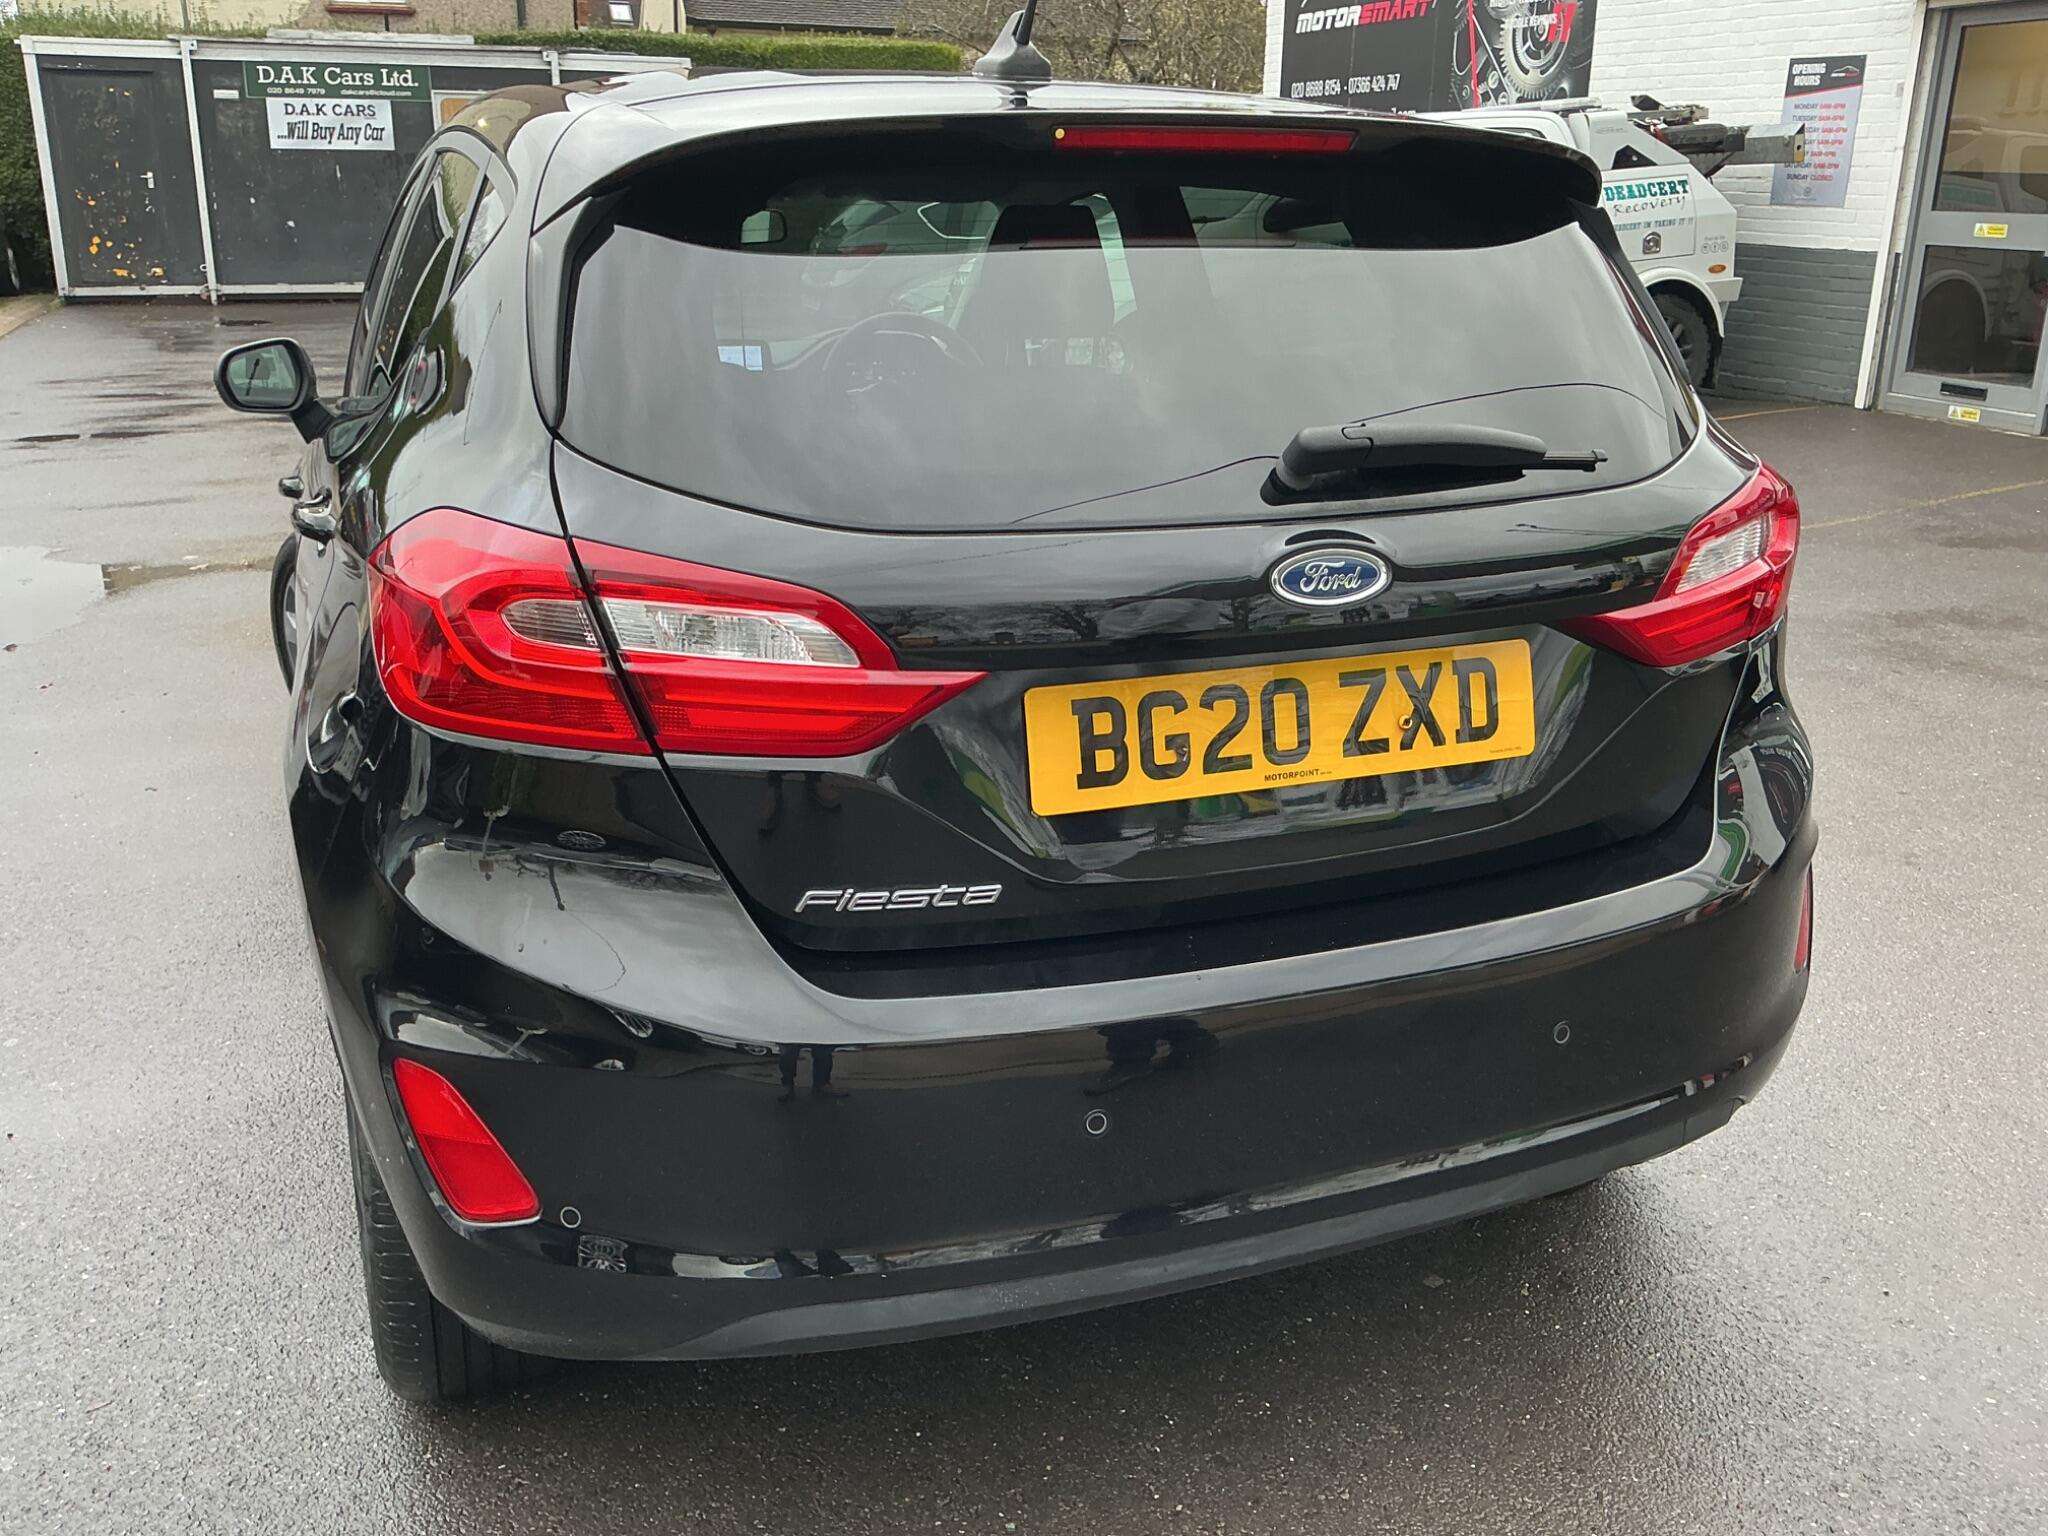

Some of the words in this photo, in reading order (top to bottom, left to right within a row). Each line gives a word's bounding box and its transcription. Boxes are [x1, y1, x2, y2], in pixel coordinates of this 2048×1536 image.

[1296, 0, 1429, 34] MOTORSMART
[256, 65, 318, 85] D.A.K
[324, 67, 375, 86] Cars
[380, 68, 419, 87] Ltd.
[1792, 63, 1827, 75] OPENING
[1291, 82, 1305, 99] 020
[1371, 75, 1386, 92] 424
[1794, 75, 1821, 86] HOURS
[284, 103, 327, 117] D.A.K
[332, 104, 376, 117] CARS
[311, 122, 336, 145] Buy
[338, 123, 362, 145] Any
[364, 123, 386, 141] Car
[1786, 173, 1808, 181] SUNDAY
[1603, 179, 1689, 202] DEADCERT
[1613, 195, 1686, 217] Recovery
[1299, 560, 1362, 593] Ford
[1071, 677, 1312, 790] BG20
[1338, 656, 1500, 758] ZXD
[1264, 768, 1320, 782] MOTORPOINT
[795, 884, 1002, 913] Fiesta
